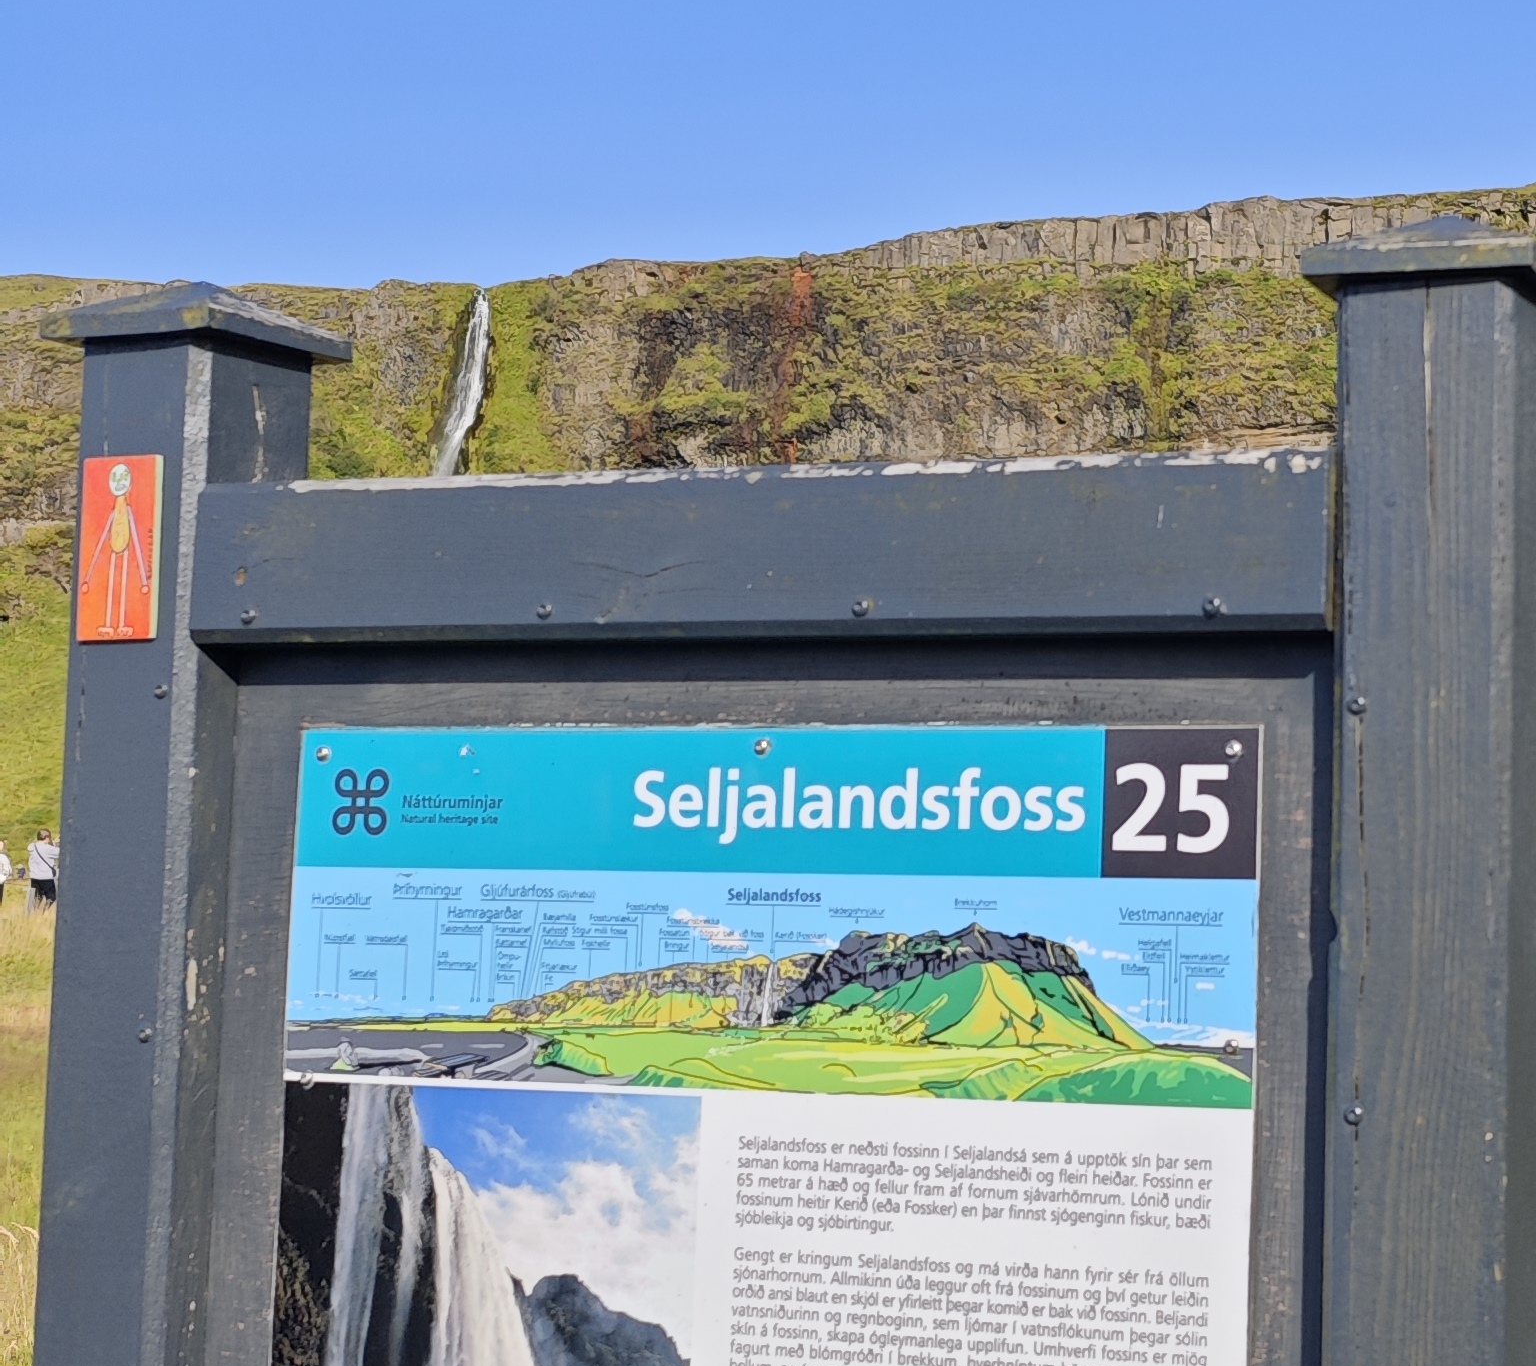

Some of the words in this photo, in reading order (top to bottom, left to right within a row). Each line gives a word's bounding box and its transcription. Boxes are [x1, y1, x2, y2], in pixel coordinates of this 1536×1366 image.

[402, 794, 504, 813] Náttúruminjar
[632, 766, 1086, 844] Seljalandsfoss
[1110, 762, 1231, 853] 25
[401, 813, 437, 825] Natural
[438, 814, 479, 827] heritage
[481, 814, 499, 825] site
[727, 887, 822, 905] Seljalandsfoss
[447, 906, 523, 923] Hamragarðar
[1118, 907, 1224, 926] Vestmannaeyjar
[738, 1136, 827, 1154] Seljalandsfoss
[830, 1145, 845, 1154] er
[848, 1142, 888, 1156] neðsti
[892, 1143, 940, 1158] fossinn
[944, 1143, 948, 1156] í
[952, 1146, 1027, 1164] Seljalandsá
[1031, 1153, 1059, 1164] sem
[1063, 1151, 1073, 1165] á
[1077, 1153, 1127, 1170] upptök
[1131, 1154, 1151, 1168] sín
[1155, 1154, 1180, 1173] þar
[1183, 1160, 1212, 1170] sem
[737, 1159, 779, 1170] saman
[782, 1156, 819, 1171] koma
[912, 1167, 930, 1181] og
[934, 1164, 1032, 1182] Seljalandsheiði
[1035, 1173, 1054, 1187] og
[1091, 1170, 1138, 1186] heiðar.
[1142, 1173, 1194, 1189] Fossinn
[1197, 1180, 1213, 1190] er
[736, 1173, 754, 1187] 65
[757, 1177, 802, 1189] metrar
[805, 1177, 814, 1190] á
[817, 1177, 848, 1192] hæð
[852, 1183, 870, 1197] og
[874, 1180, 909, 1195] fellur
[912, 1181, 945, 1196] fram
[948, 1184, 963, 1197] af
[967, 1184, 1018, 1200] fornum
[1130, 1192, 1170, 1208] Lónið
[1174, 1195, 1212, 1210] undir
[735, 1191, 793, 1207] fossinum
[796, 1194, 830, 1209] heitir
[834, 1196, 868, 1211] Kerið
[871, 1198, 900, 1216] (eða
[904, 1200, 957, 1220] Fossker)
[960, 1207, 978, 1217] en
[981, 1204, 1005, 1222] þar
[1007, 1205, 1047, 1220] finnst
[1175, 1213, 1211, 1229] bæði
[796, 1217, 814, 1231] og
[733, 1247, 775, 1266] Gengt
[778, 1253, 793, 1263] er
[797, 1250, 852, 1270] kringum
[954, 1264, 973, 1278] og
[978, 1261, 1000, 1276] má
[1004, 1263, 1039, 1278] virða
[1043, 1264, 1079, 1280] hann
[1084, 1266, 1113, 1285] fyrir
[1117, 1269, 1139, 1284] sér
[1143, 1270, 1164, 1285] frá
[1168, 1271, 1209, 1288] öllum
